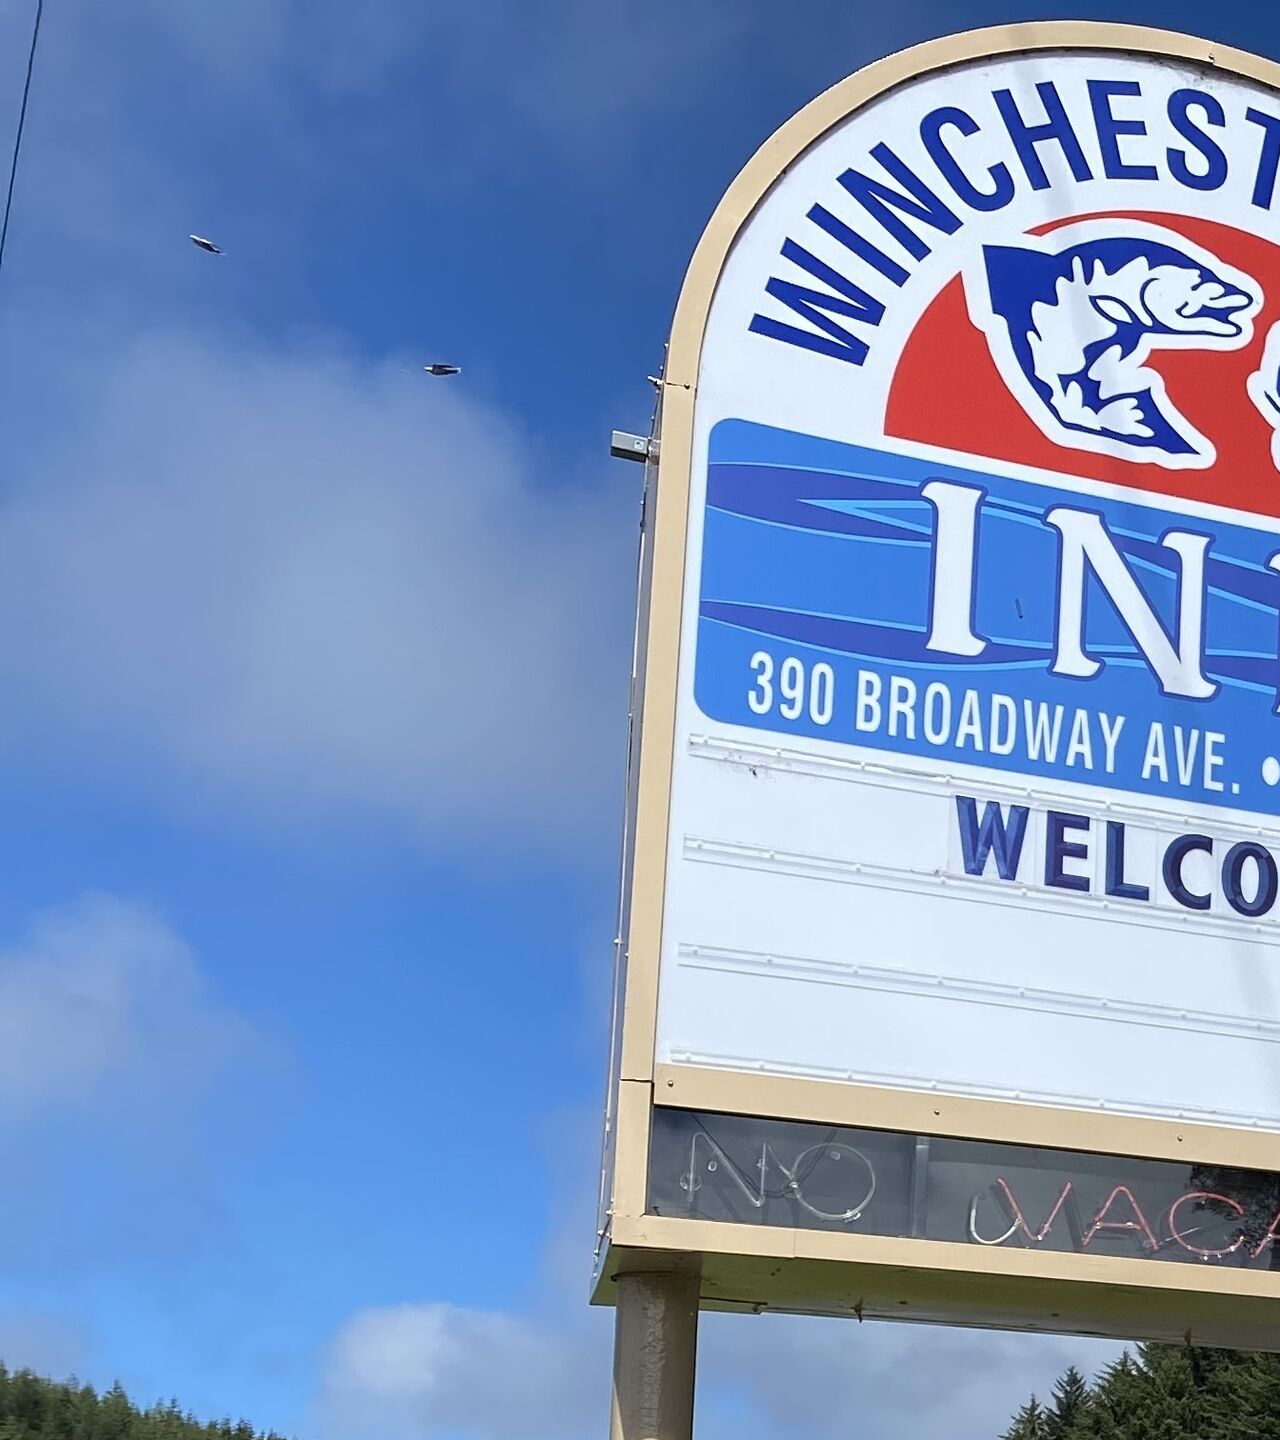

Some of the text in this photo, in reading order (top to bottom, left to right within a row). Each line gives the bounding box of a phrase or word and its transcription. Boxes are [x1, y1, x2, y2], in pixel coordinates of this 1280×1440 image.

[748, 651, 835, 726] 390
[856, 670, 1125, 766] BROADWAY
[1141, 723, 1240, 796] AVE.
[688, 1131, 877, 1221] NO
